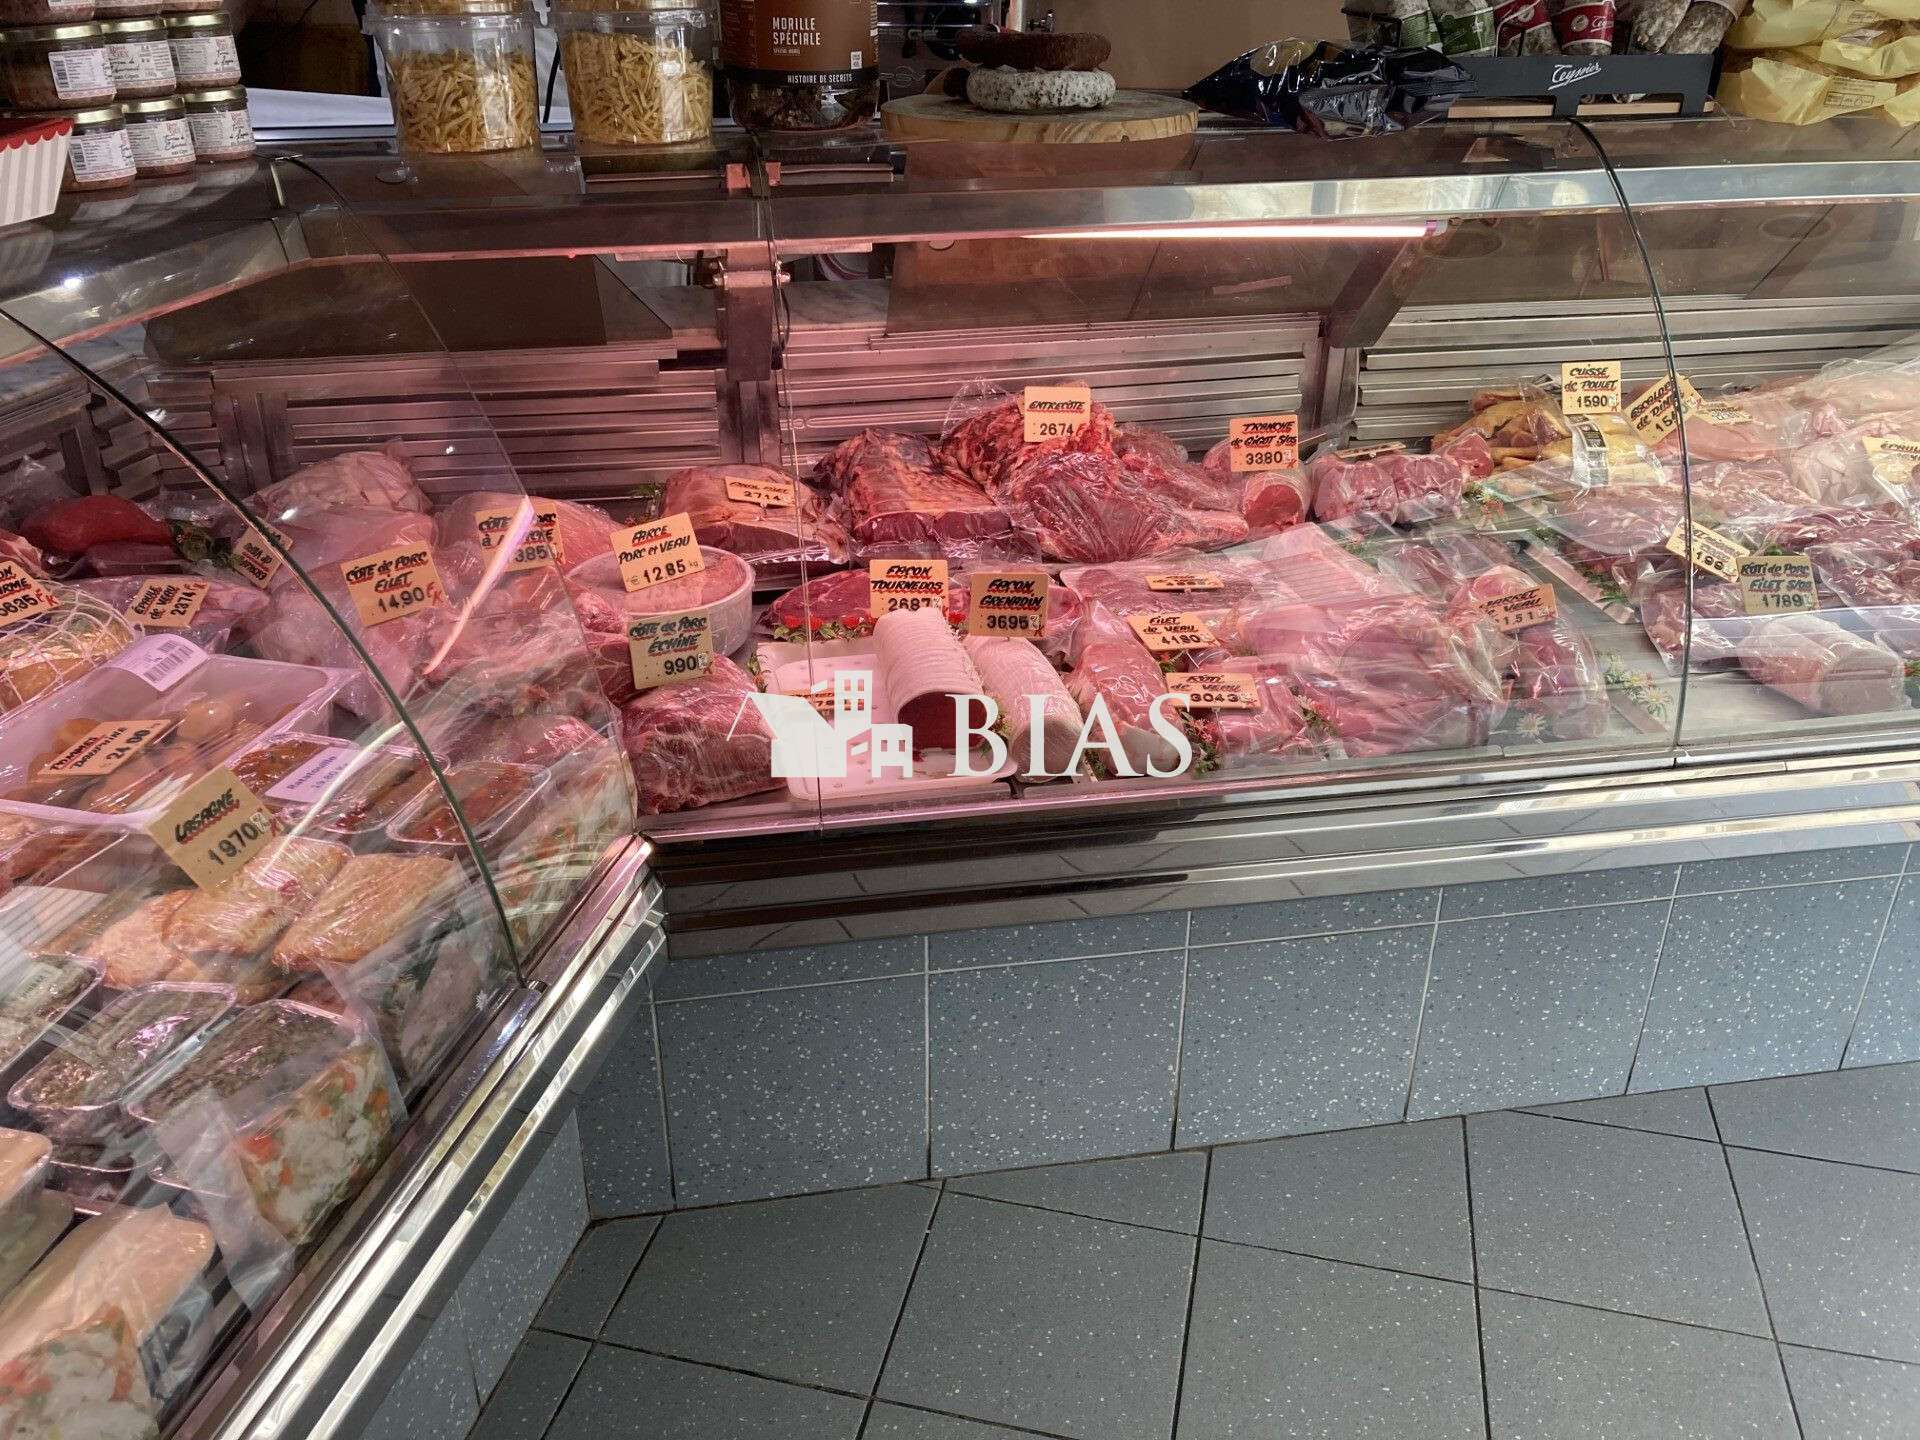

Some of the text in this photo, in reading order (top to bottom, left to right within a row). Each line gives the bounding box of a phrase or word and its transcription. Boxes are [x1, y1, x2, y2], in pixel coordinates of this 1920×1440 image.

[772, 17, 816, 31] MORILLE
[773, 29, 821, 46] SPÉCIALE
[787, 73, 853, 84] HISTOIRE DE SECRETS
[1570, 367, 1609, 377] CUISSE
[631, 525, 669, 544] FARCE
[618, 548, 646, 565] PORC
[659, 535, 691, 554] VEAU
[886, 564, 933, 578] FAÇON
[870, 579, 945, 591] TOURNEDOS
[988, 578, 1036, 592] FAÇON
[980, 594, 1044, 608] GRENADIN
[1163, 625, 1200, 633] VEAU
[175, 787, 235, 843] LASAGNE
